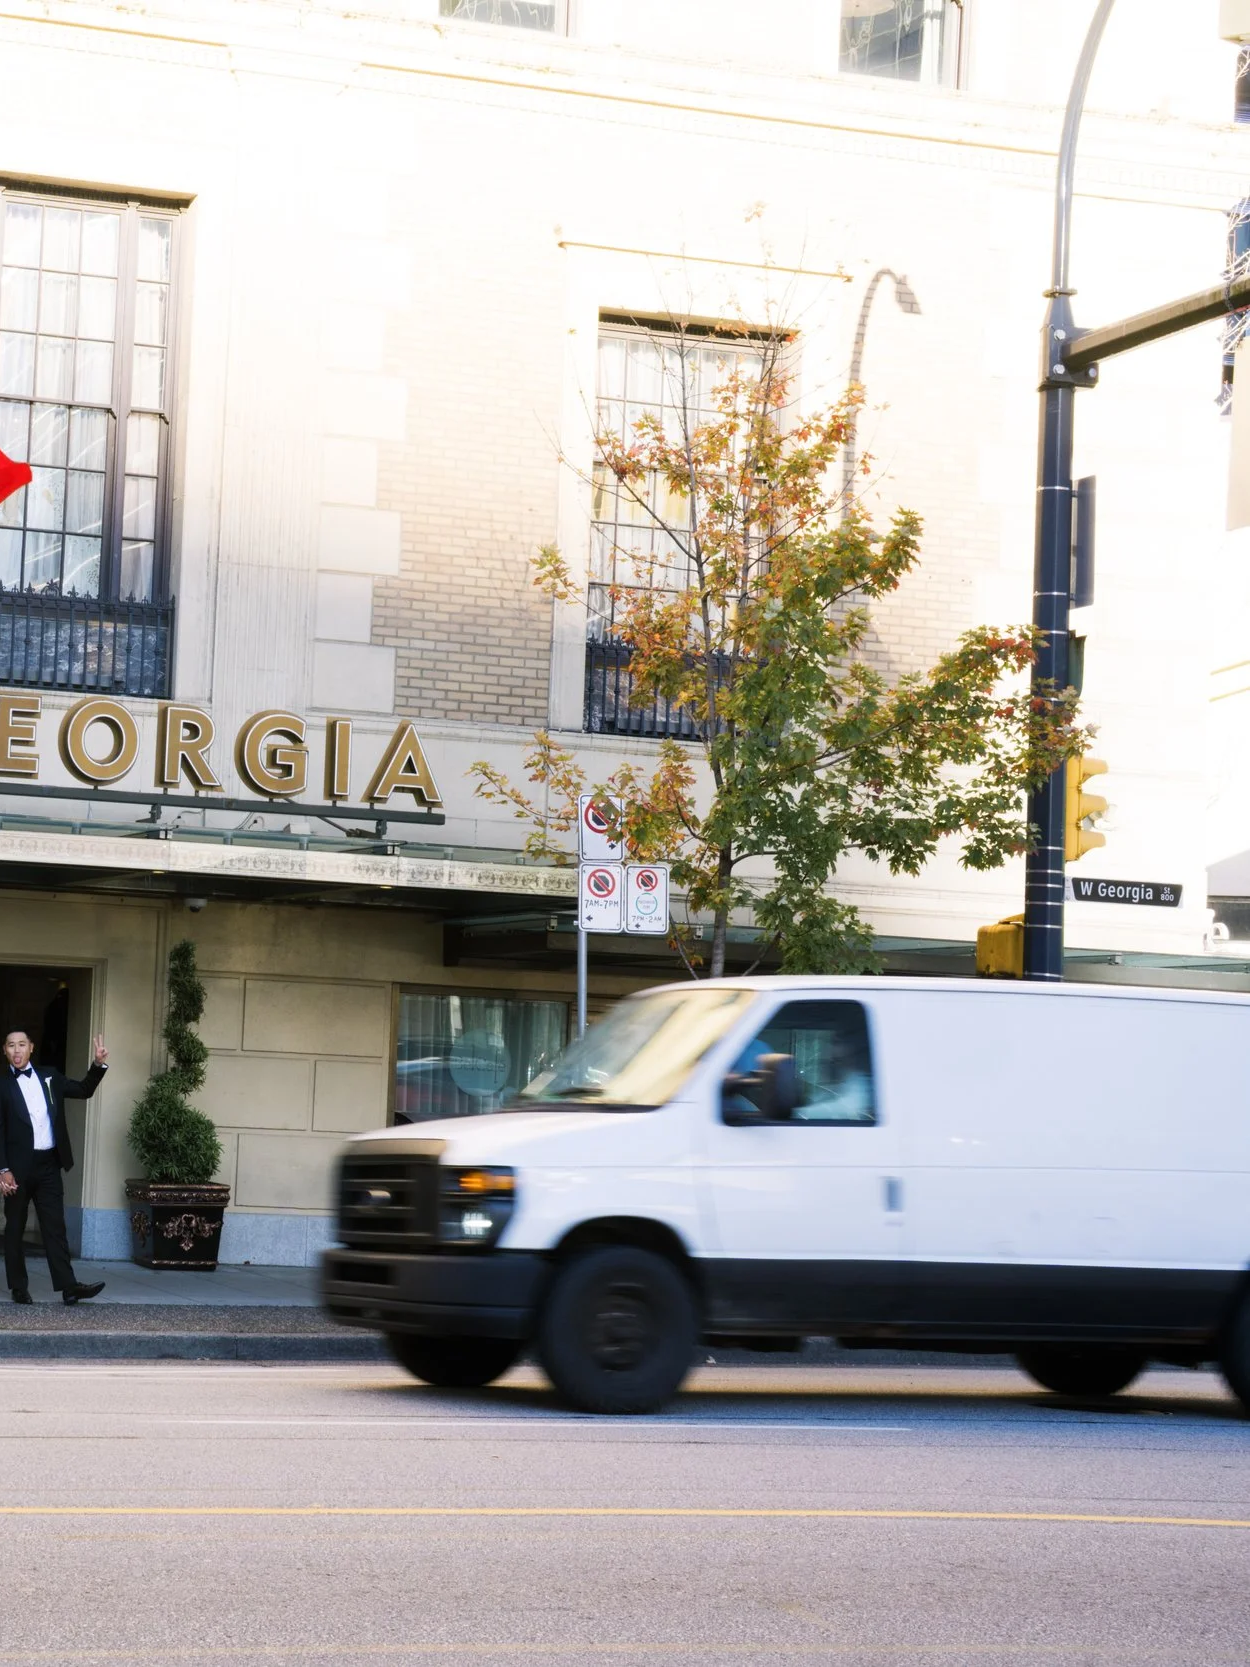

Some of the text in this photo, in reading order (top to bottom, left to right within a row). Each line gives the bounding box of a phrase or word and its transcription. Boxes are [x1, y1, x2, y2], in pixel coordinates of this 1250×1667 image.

[1080, 881, 1154, 903] W Georgia
[1160, 893, 1174, 902] 800
